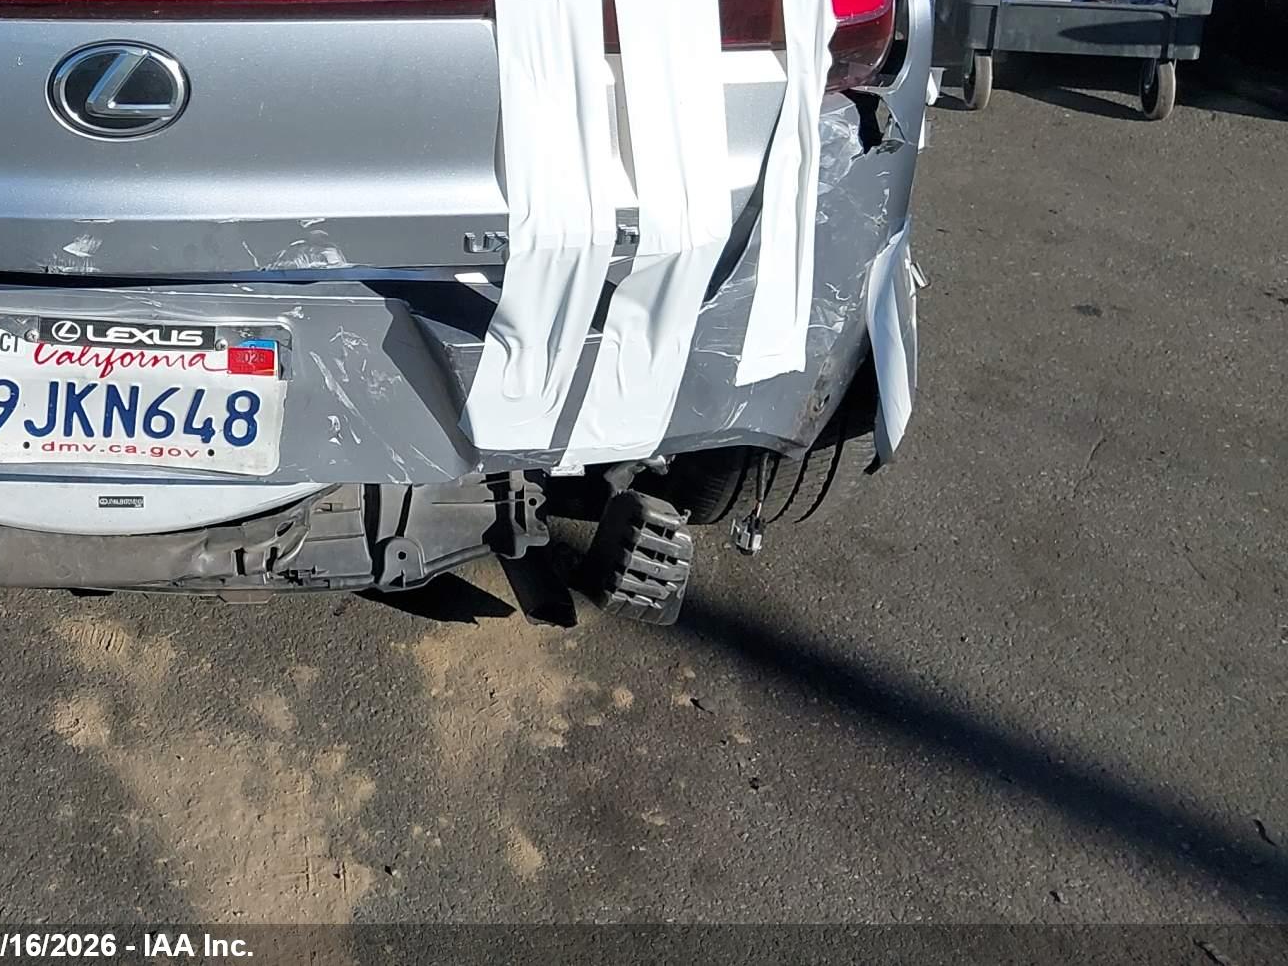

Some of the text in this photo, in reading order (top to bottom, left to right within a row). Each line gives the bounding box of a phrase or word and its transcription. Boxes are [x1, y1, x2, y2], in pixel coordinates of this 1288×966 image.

[86, 324, 203, 346] LEXUS
[33, 342, 228, 379] California
[41, 442, 199, 459] dmv.ca.gov
